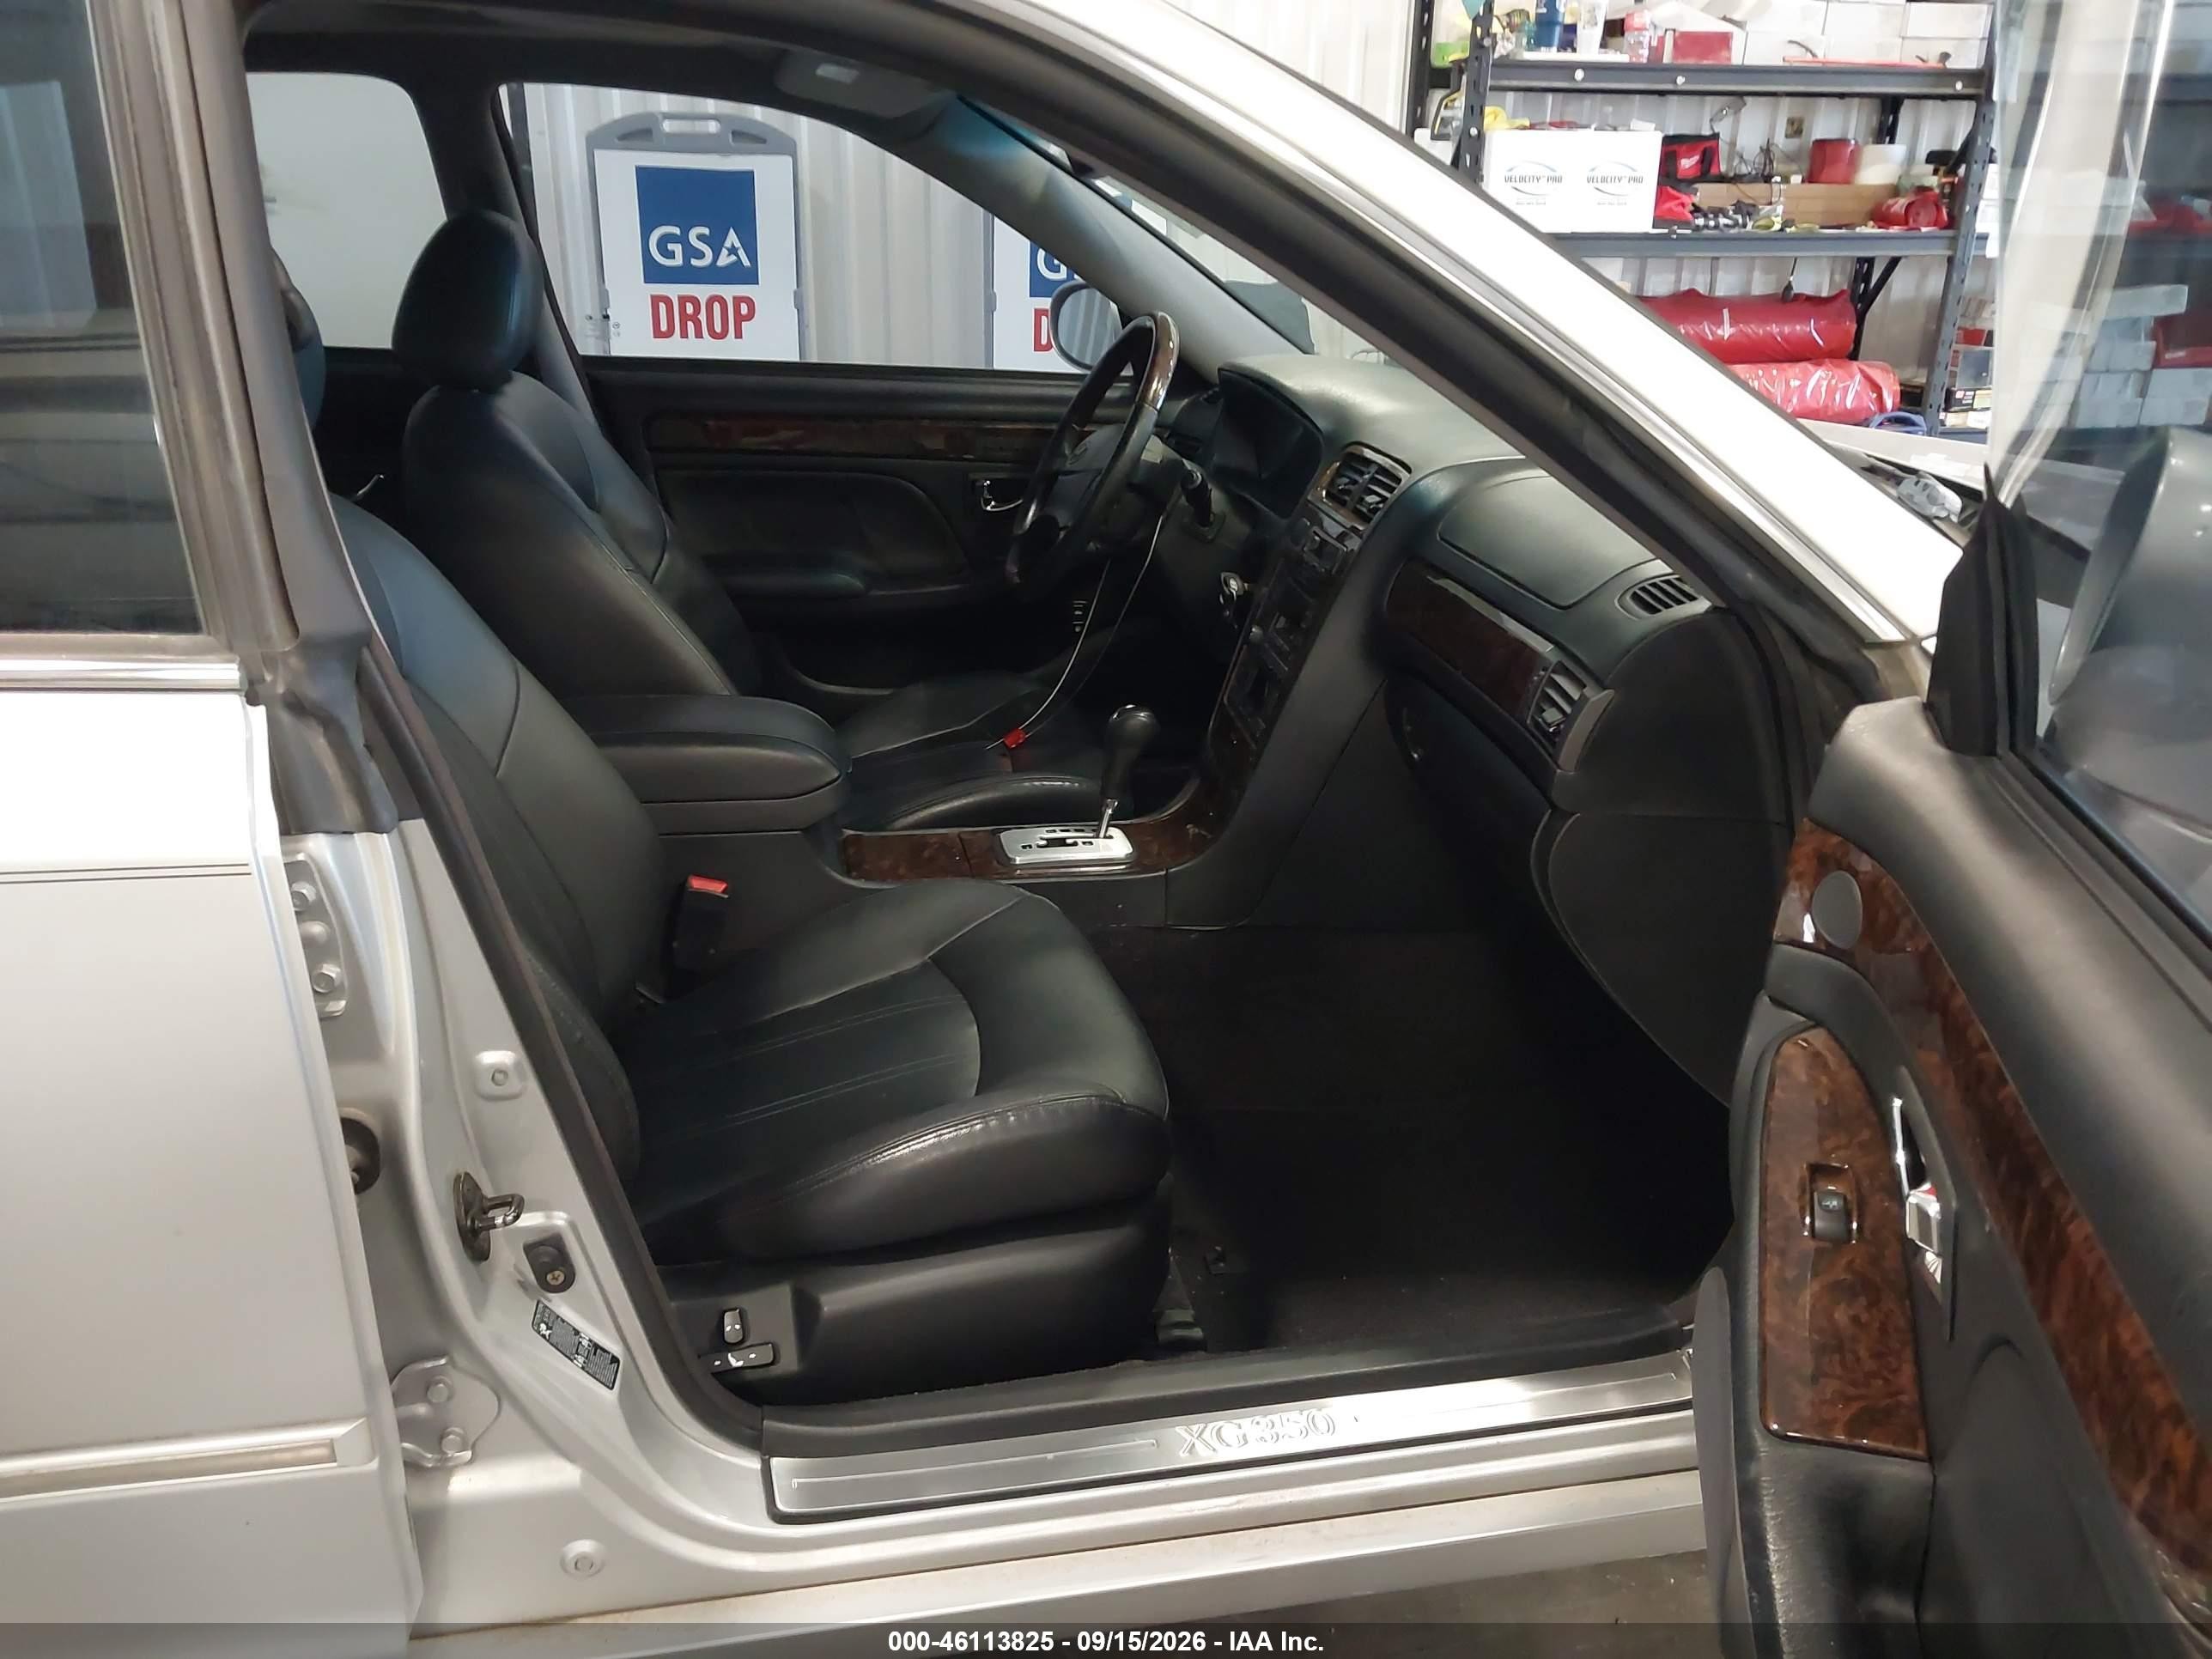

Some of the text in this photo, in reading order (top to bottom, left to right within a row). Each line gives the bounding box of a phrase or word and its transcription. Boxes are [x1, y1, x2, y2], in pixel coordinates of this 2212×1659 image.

[1504, 174, 1563, 184] VELOCITY PRO
[1586, 174, 1644, 184] VELOCITY PRO
[648, 225, 751, 268] GSA
[649, 294, 757, 340] DROP
[1176, 1407, 1336, 1457] XG350
